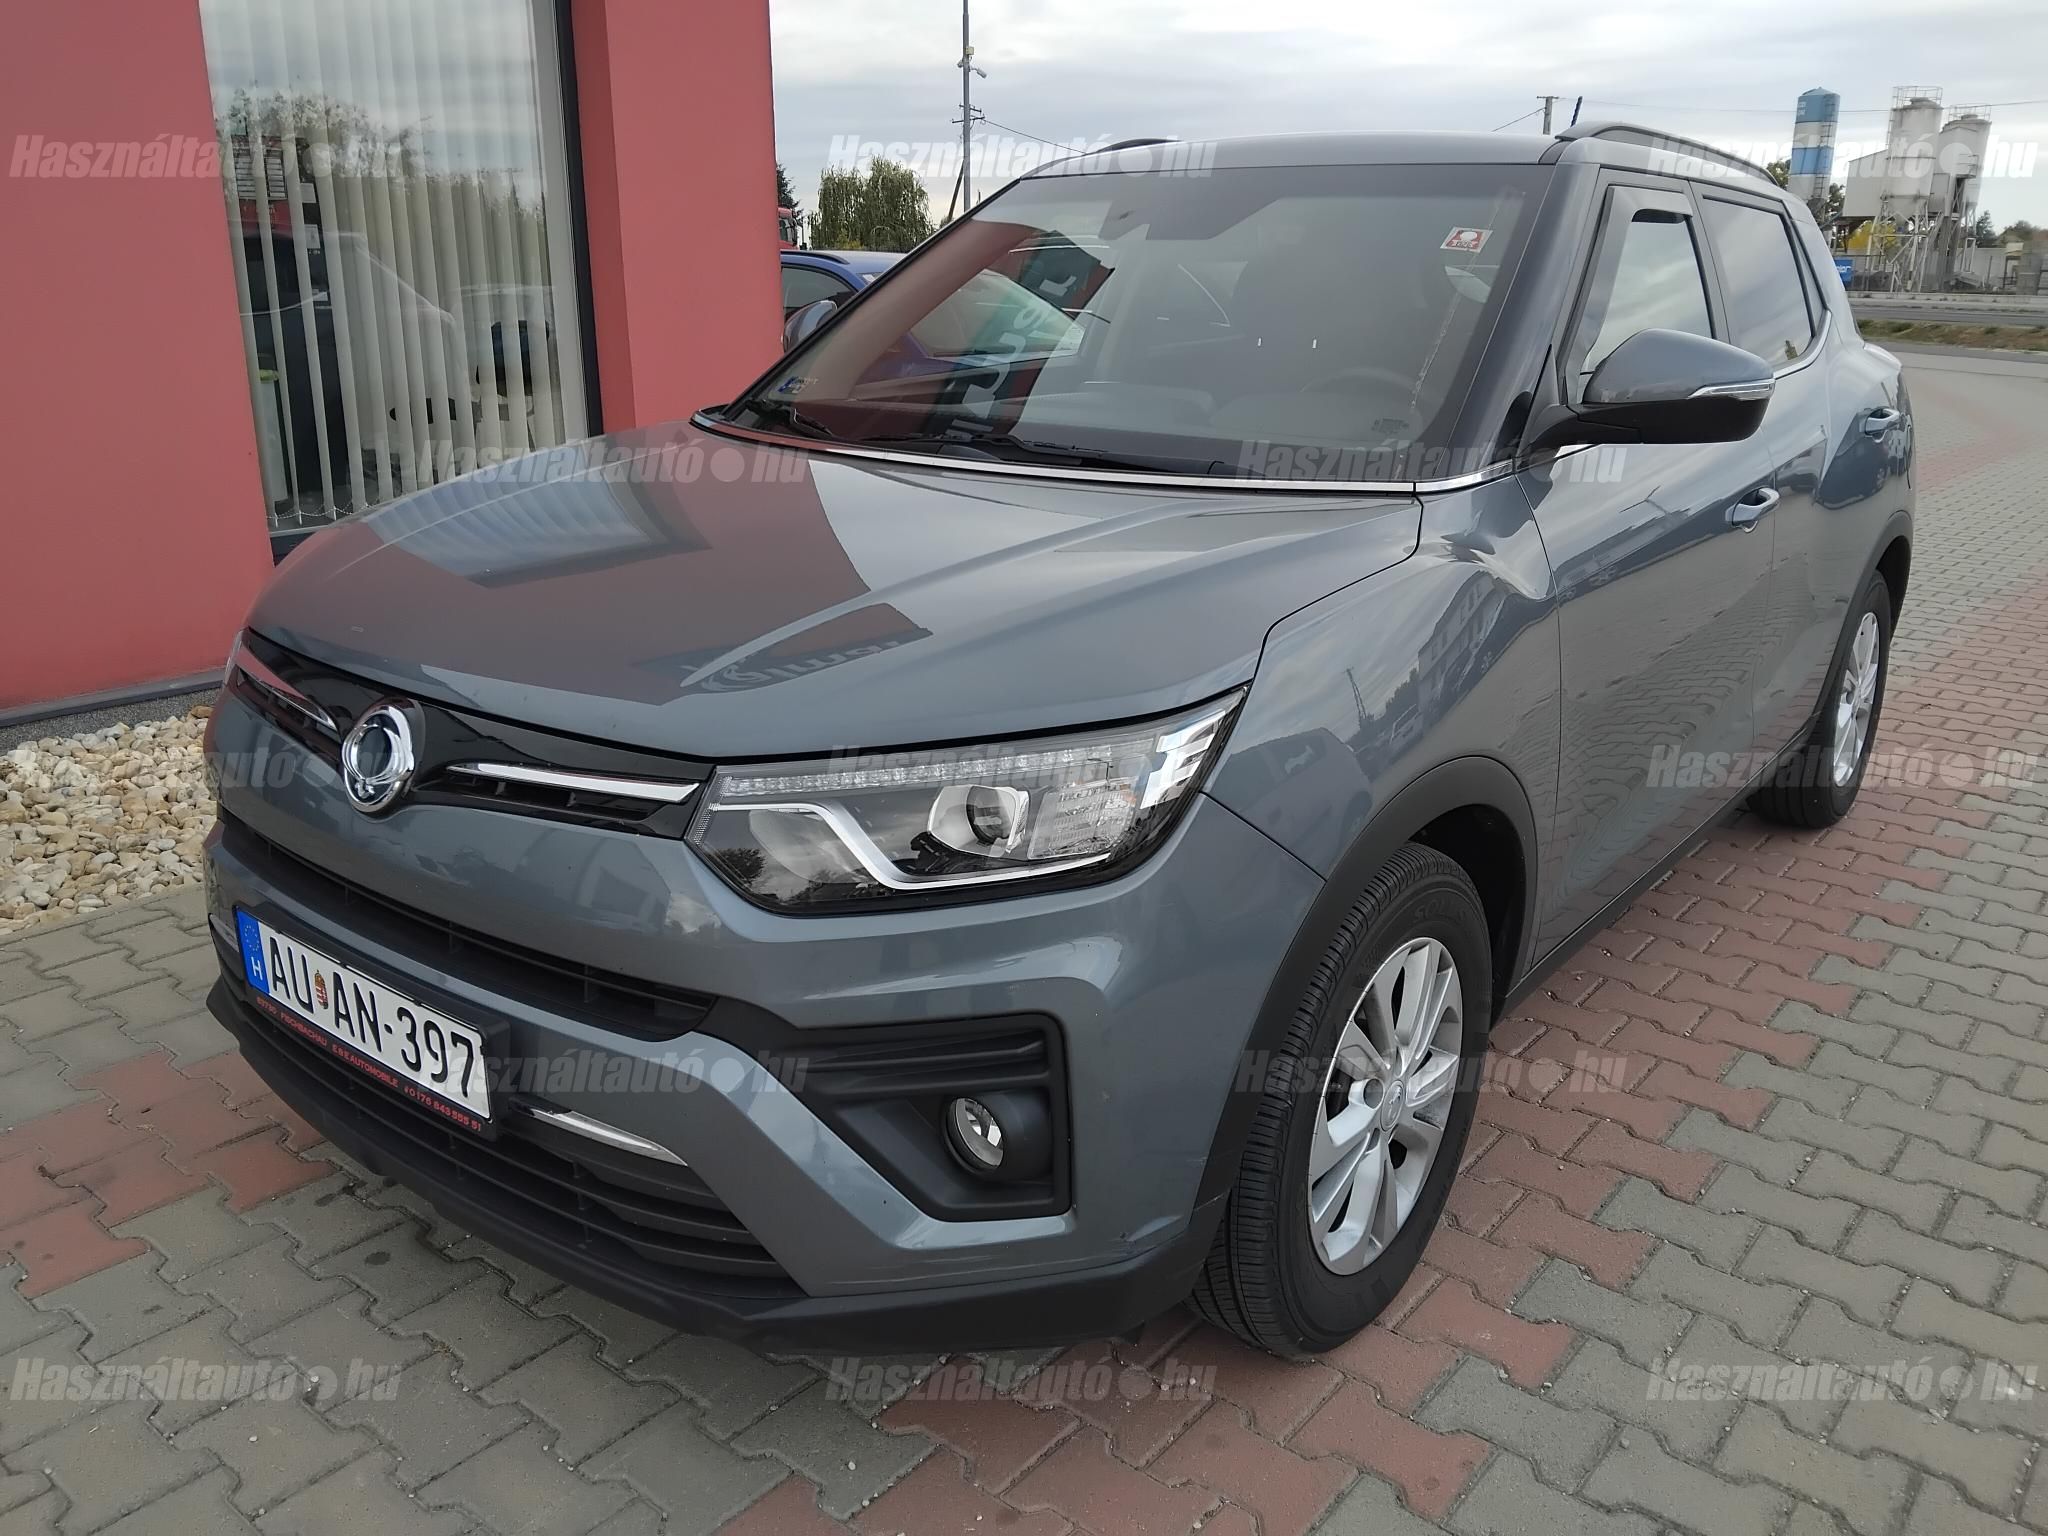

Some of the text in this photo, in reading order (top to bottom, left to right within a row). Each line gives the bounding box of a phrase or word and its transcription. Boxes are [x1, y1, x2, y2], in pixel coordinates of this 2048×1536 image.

[250, 956, 263, 981] H
[269, 936, 475, 1098] AU AN-397
